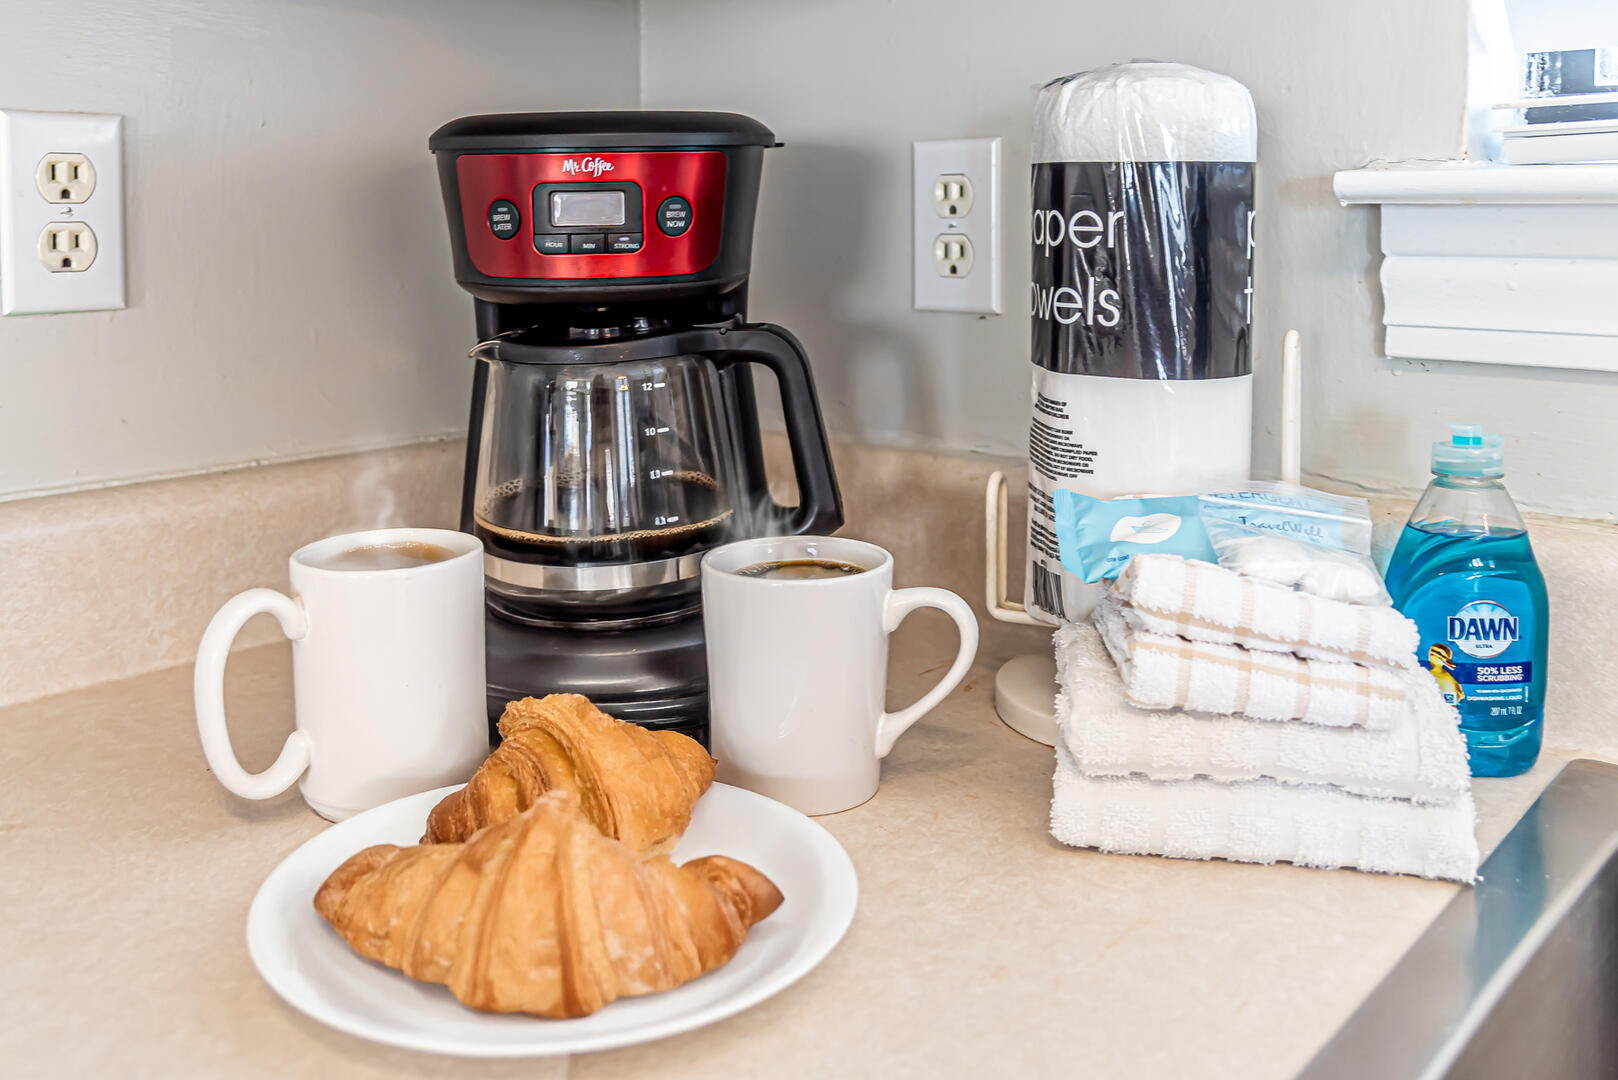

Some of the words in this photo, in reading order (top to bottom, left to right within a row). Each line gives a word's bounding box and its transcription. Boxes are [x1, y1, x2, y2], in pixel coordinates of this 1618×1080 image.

[581, 156, 615, 178] Coffee
[492, 213, 511, 222] BREW
[666, 211, 686, 219] BREW
[494, 223, 513, 231] LATER
[666, 220, 686, 228] NOW
[641, 382, 653, 392] 12
[644, 427, 656, 436] 10
[1449, 616, 1518, 641] DAWN
[1476, 666, 1499, 675] 50%
[1500, 665, 1523, 675] LESS
[1476, 674, 1523, 682] SCRUBBING
